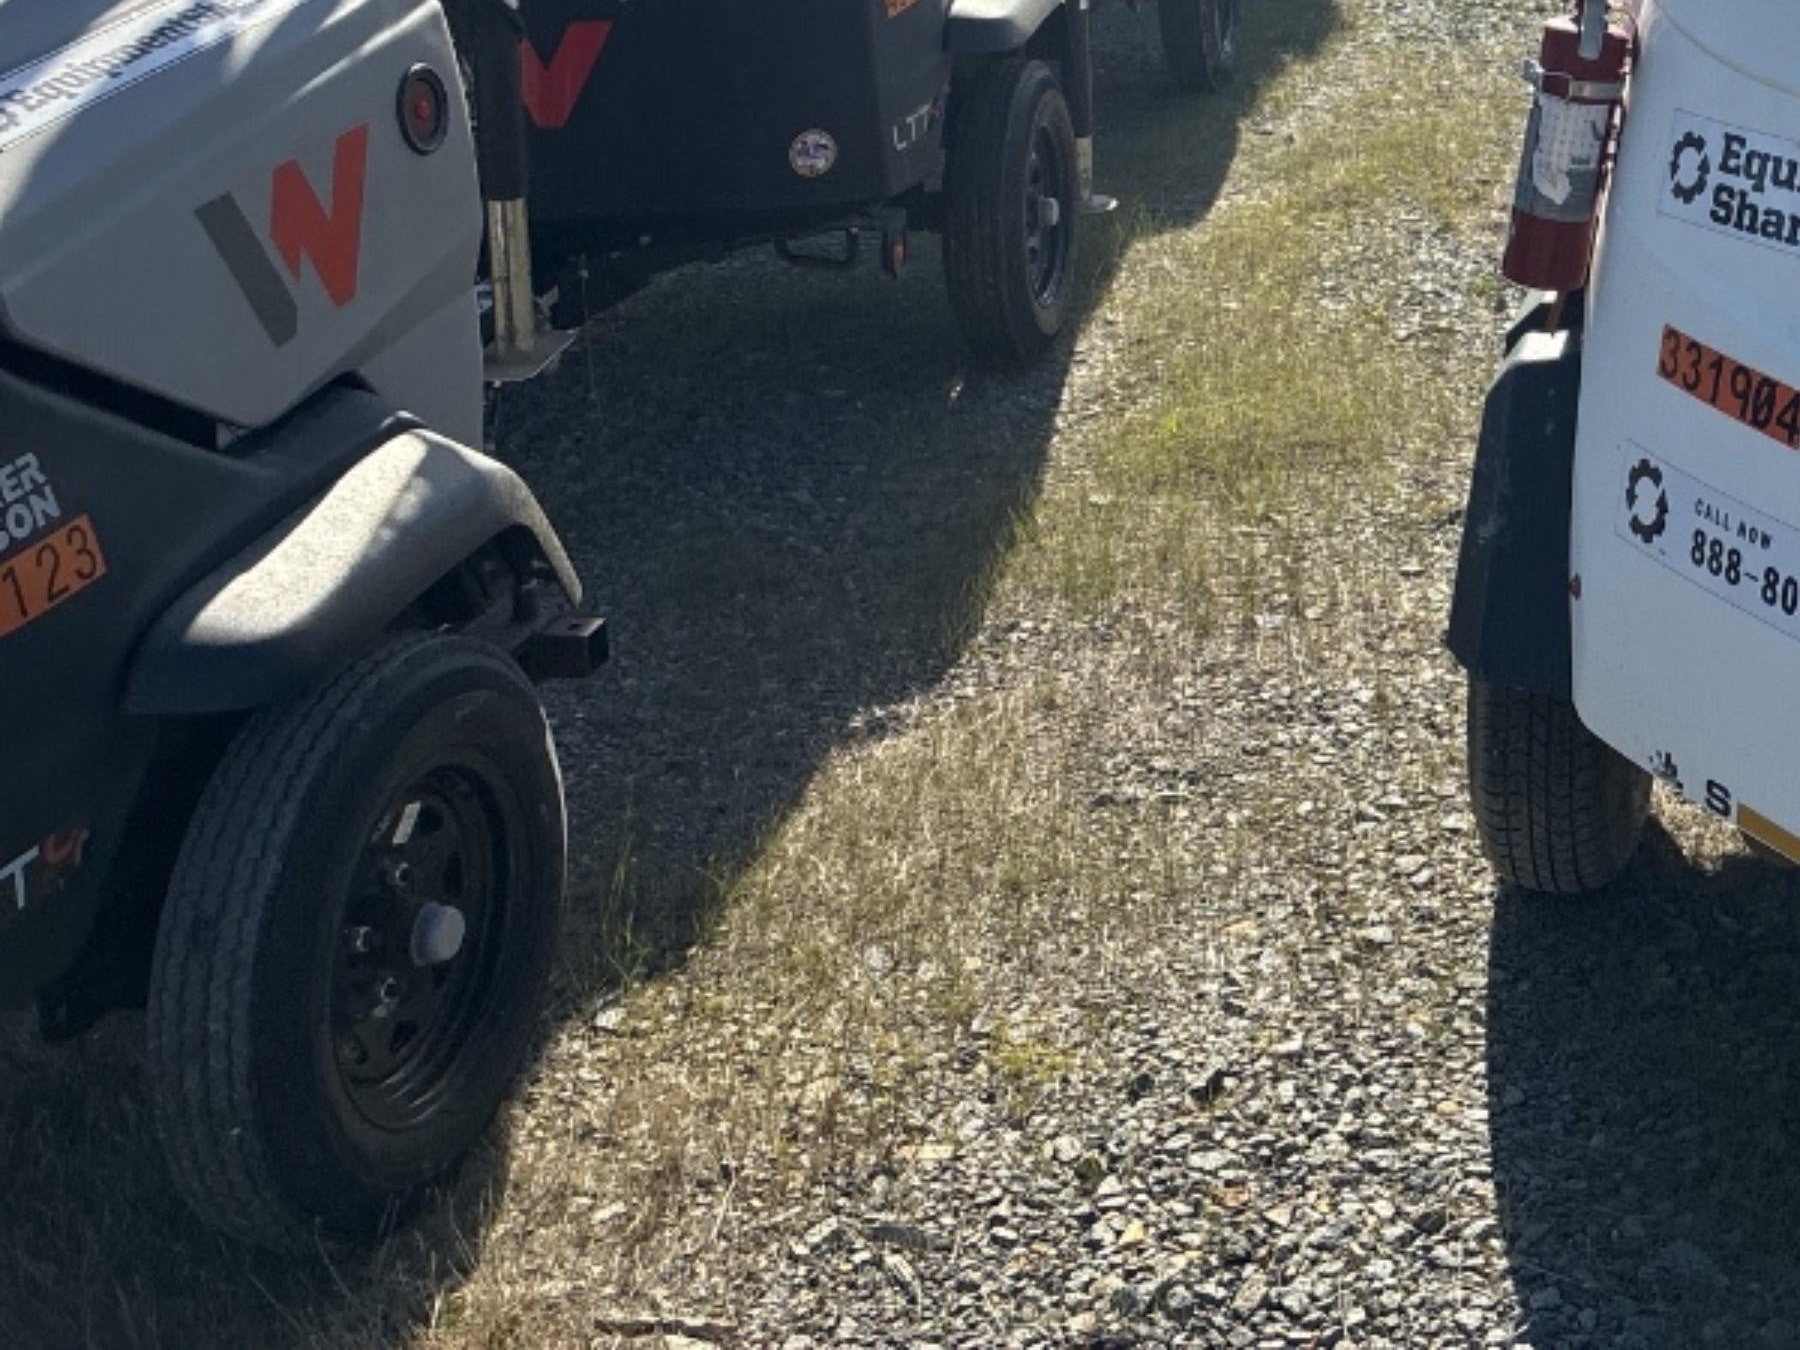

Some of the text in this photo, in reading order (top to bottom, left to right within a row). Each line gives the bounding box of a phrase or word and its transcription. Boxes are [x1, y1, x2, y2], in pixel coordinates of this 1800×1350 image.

[1660, 328, 1800, 445] 331904
[1694, 498, 1773, 550] CALL NOW
[0, 525, 97, 618] 123
